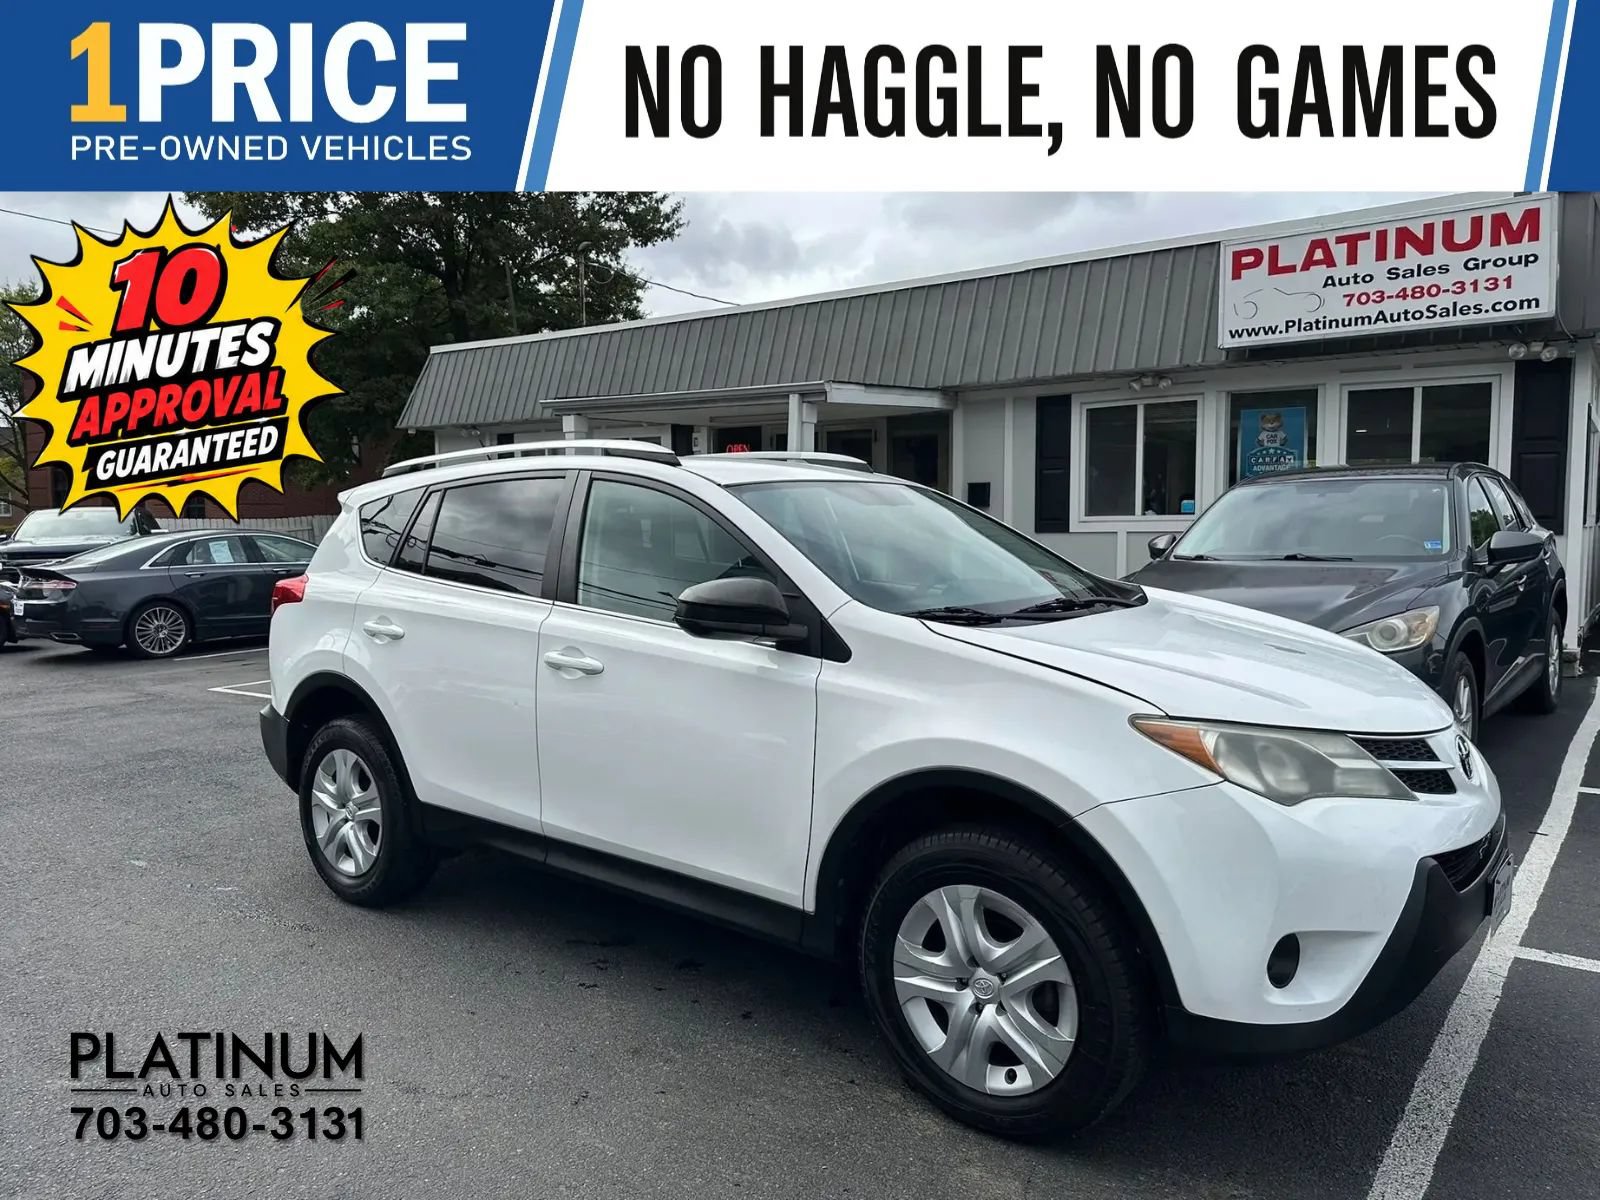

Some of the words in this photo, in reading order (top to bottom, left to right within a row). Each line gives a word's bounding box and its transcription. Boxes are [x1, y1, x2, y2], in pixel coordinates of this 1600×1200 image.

[1231, 207, 1541, 280] PLATINUM
[1322, 273, 1375, 289] Auto
[1386, 262, 1450, 281] Sales
[1462, 252, 1540, 272] Group
[1342, 275, 1513, 307] 703-480-3131
[1228, 296, 1541, 340] www.PlatinumAutoSales.com
